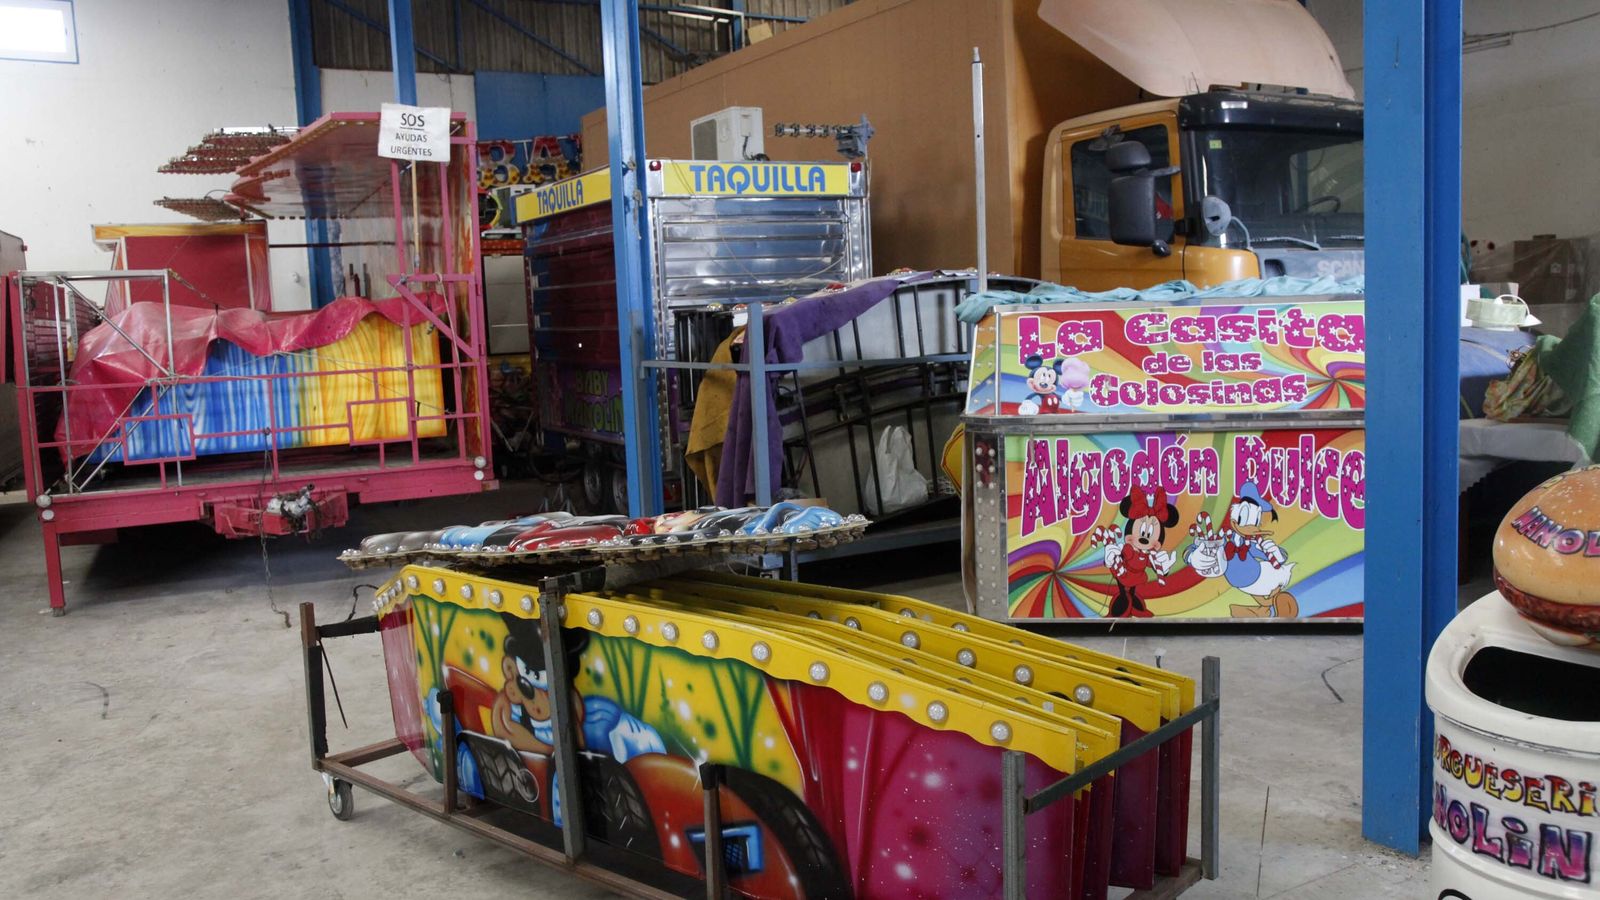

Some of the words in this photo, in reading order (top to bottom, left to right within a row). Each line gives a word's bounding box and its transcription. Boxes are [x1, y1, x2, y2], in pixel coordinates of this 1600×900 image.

[400, 112, 425, 127] SOS
[390, 145, 433, 157] URGENTES
[395, 132, 428, 143] AYUDAS
[689, 164, 826, 194] TAQUILLA
[536, 179, 584, 214] TAQUILLA
[1018, 315, 1103, 365] La
[1124, 308, 1365, 353] Casita
[1142, 352, 1192, 375] de
[1203, 350, 1263, 373] las
[1089, 374, 1308, 407] Golosinas
[1021, 434, 1220, 537] Algodón
[1233, 434, 1365, 530] Dulce
